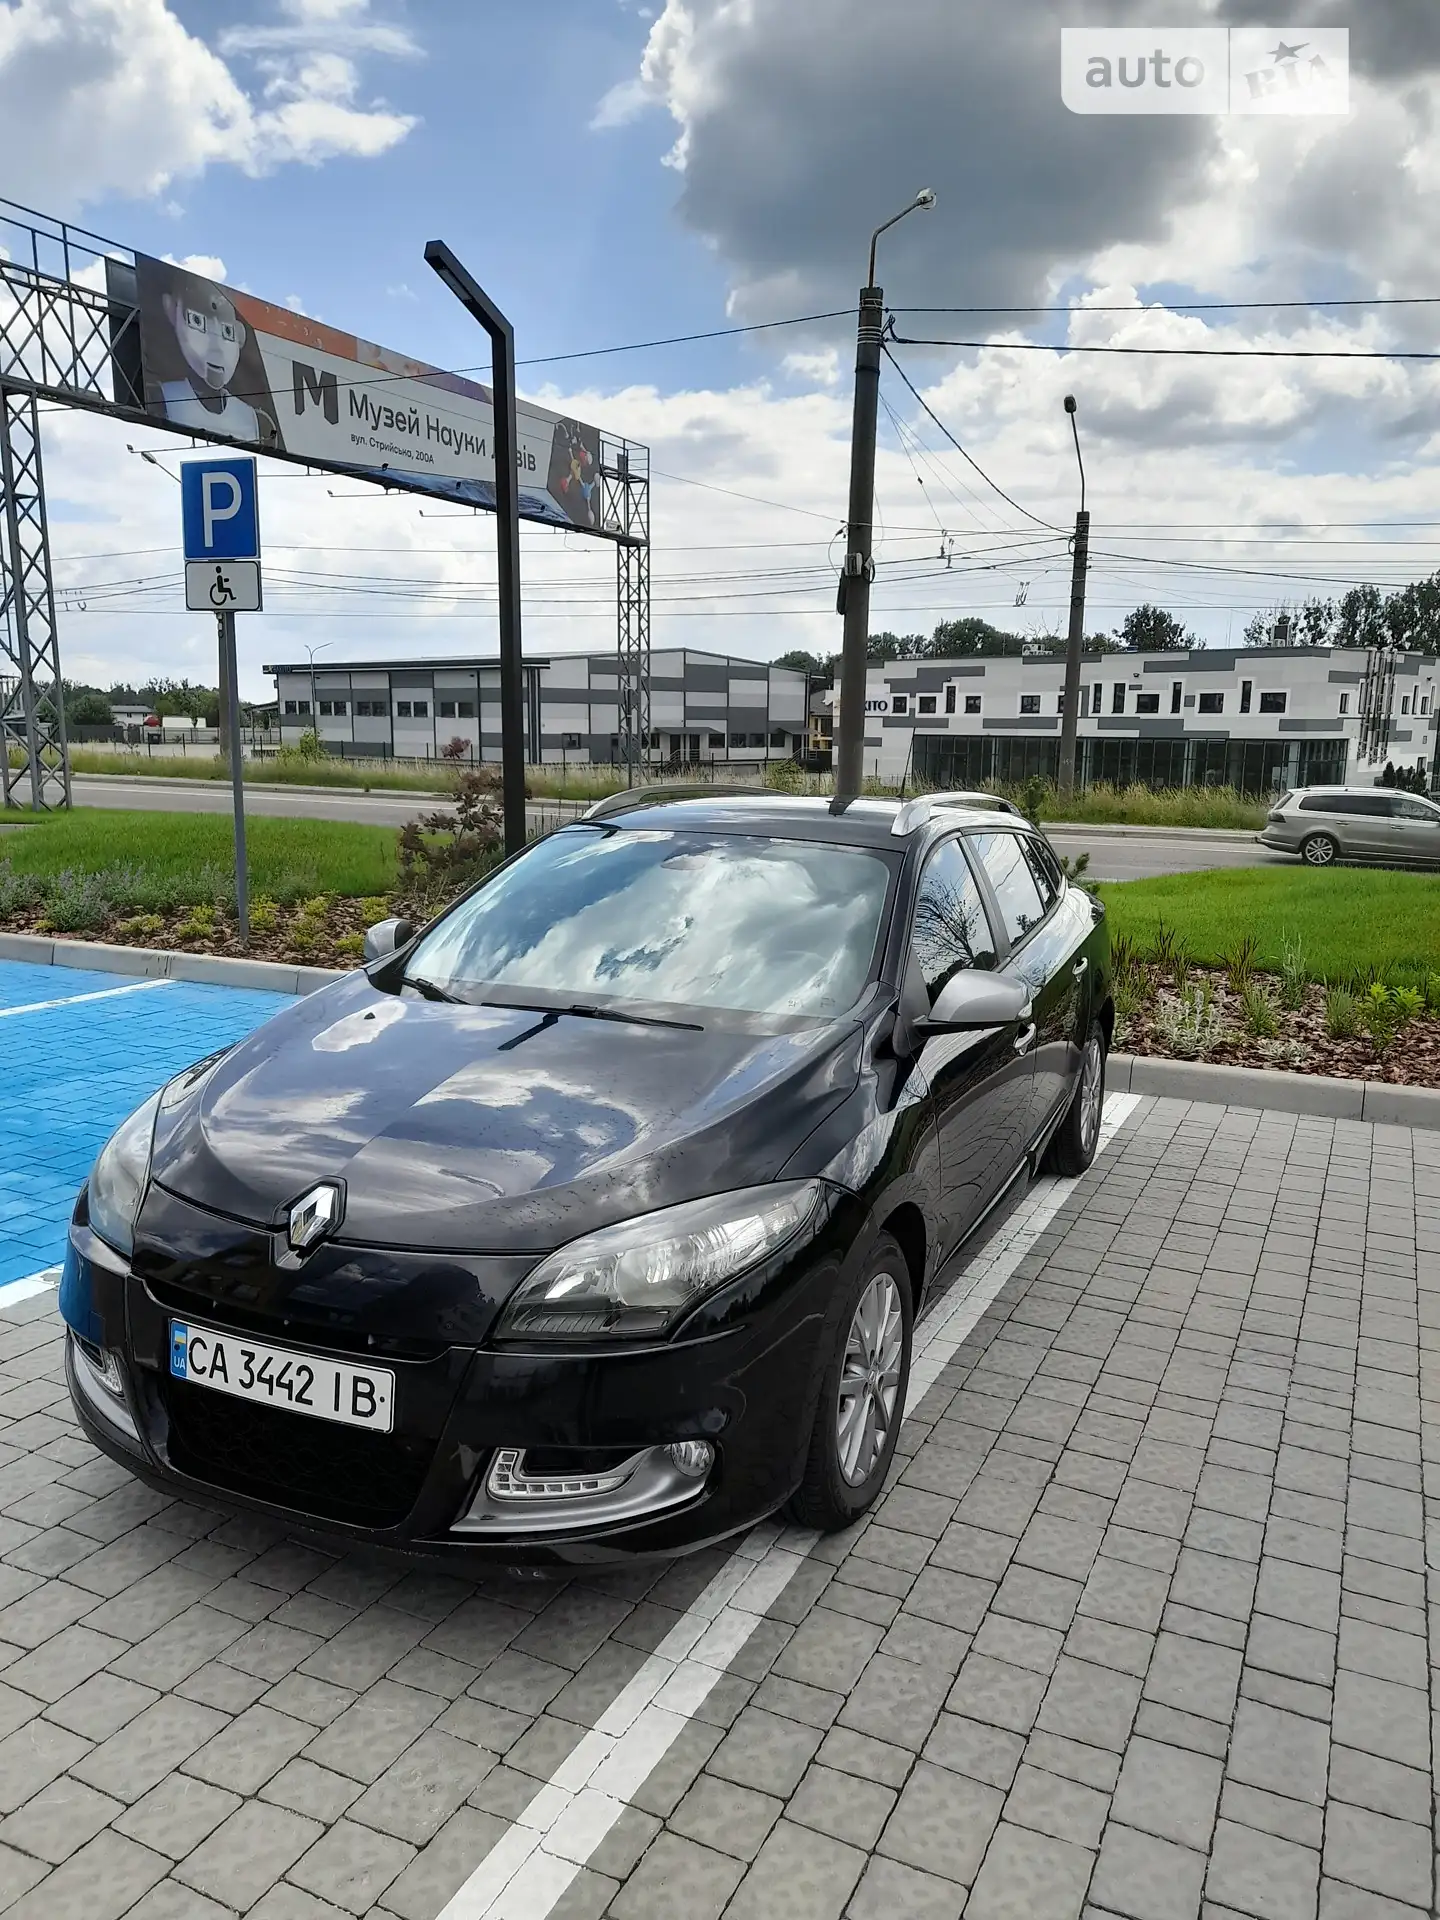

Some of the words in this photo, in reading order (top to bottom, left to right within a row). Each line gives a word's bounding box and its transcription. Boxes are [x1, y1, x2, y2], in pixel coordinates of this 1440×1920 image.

[349, 388, 420, 437] Музей
[426, 414, 487, 457] Науки
[350, 433, 368, 446] вул.
[369, 436, 413, 460] Стрийська,
[415, 450, 435, 464] 200А
[202, 472, 242, 548] P
[174, 1356, 186, 1369] UA
[189, 1337, 229, 1383] CA
[239, 1349, 314, 1406] 3442
[334, 1372, 377, 1418] IB
